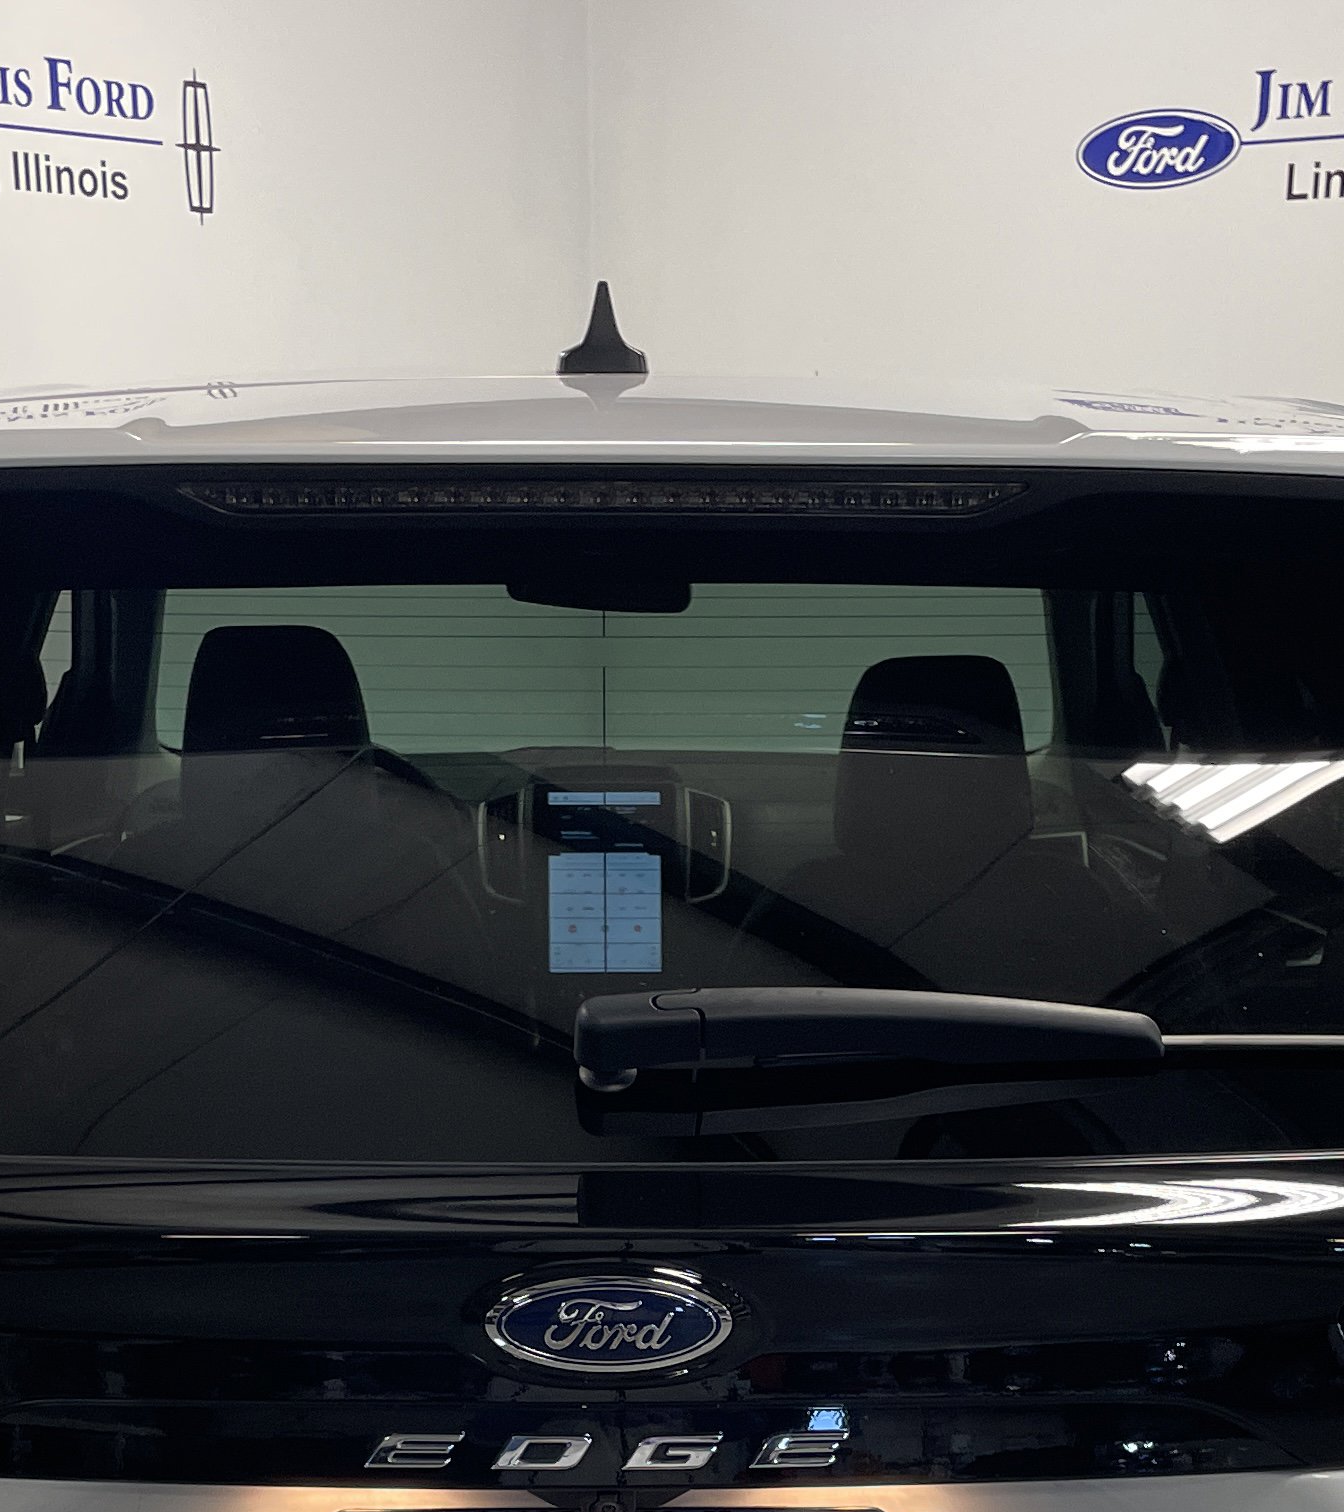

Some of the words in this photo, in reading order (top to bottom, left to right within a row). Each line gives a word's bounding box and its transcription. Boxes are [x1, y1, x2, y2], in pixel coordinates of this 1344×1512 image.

[43, 56, 155, 122] FORD
[1250, 68, 1332, 131] JIM
[11, 151, 129, 200] Illinois
[364, 1430, 850, 1470] EDGE
